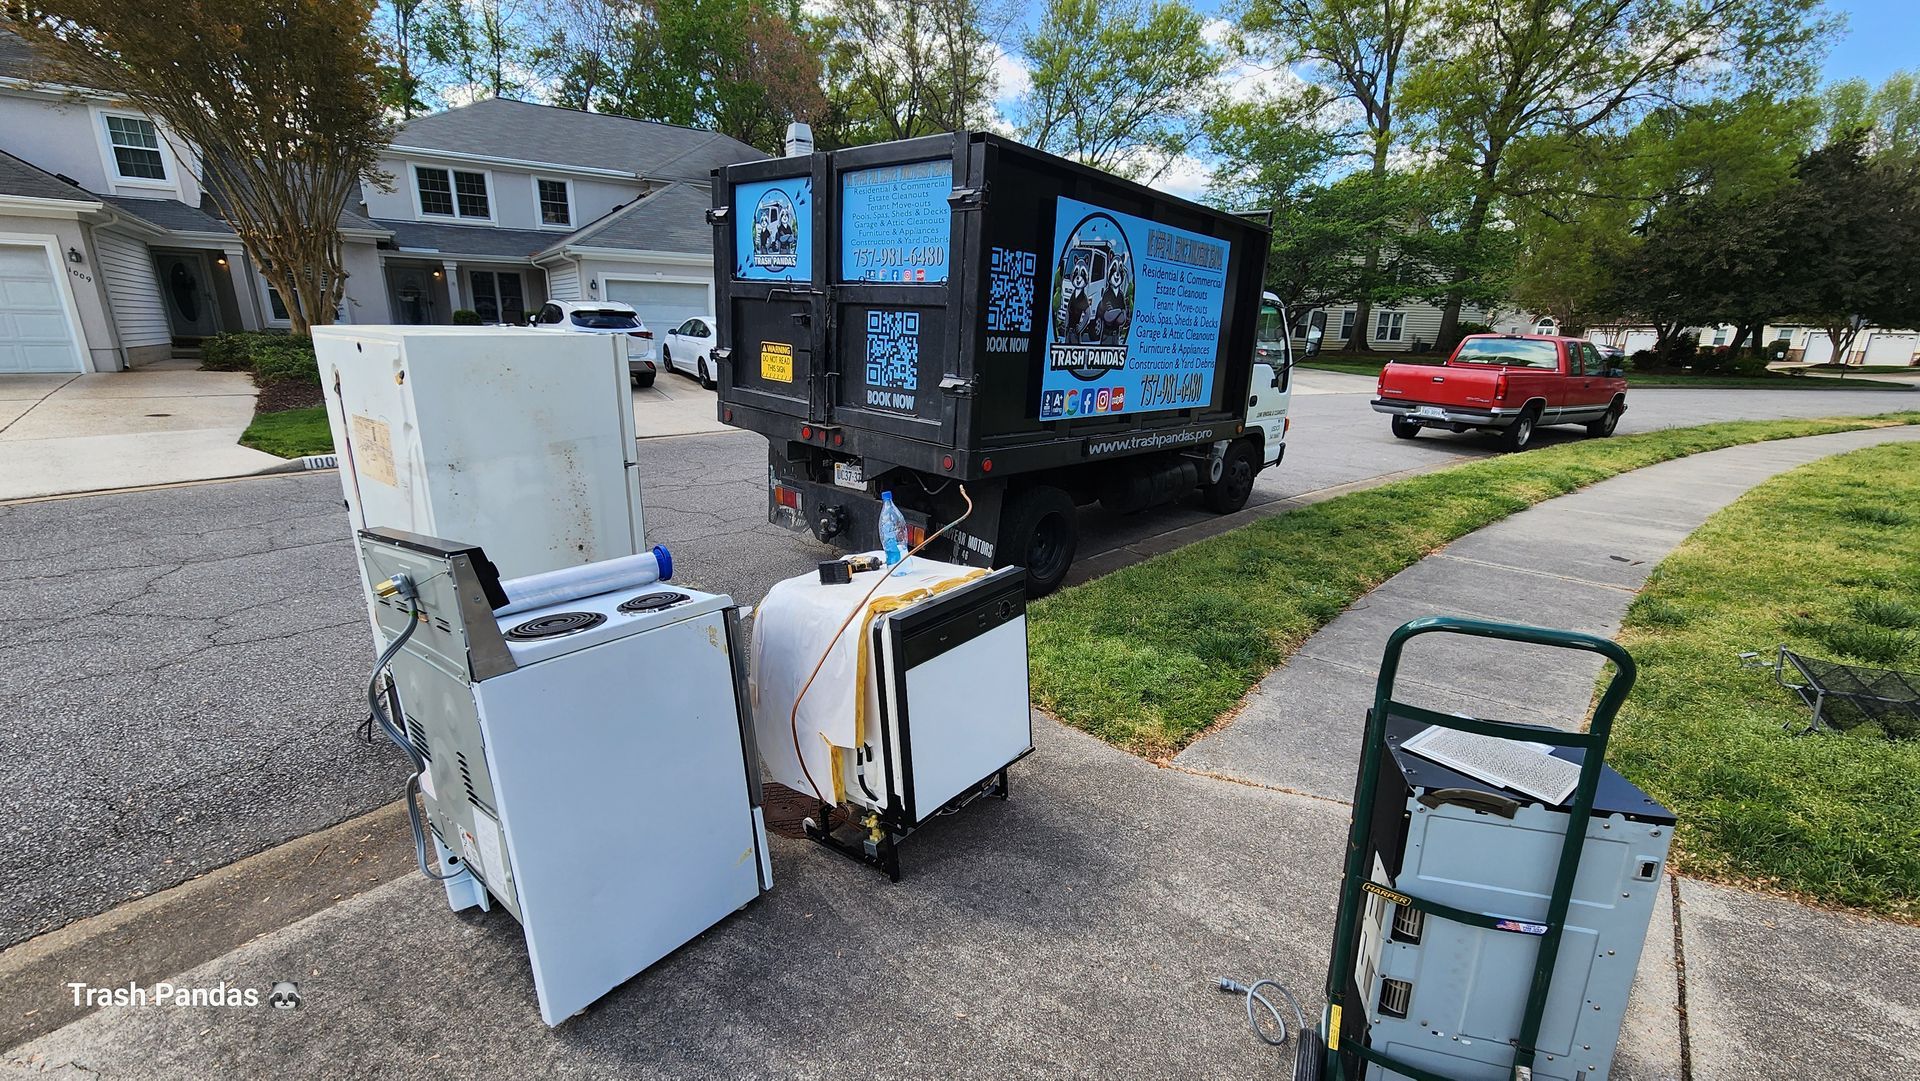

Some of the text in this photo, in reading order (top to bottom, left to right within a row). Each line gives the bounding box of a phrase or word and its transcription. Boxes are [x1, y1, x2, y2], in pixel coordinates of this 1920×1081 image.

[853, 186, 890, 195] Residential
[900, 180, 947, 190] Commercial
[891, 191, 929, 200] Cleanouts
[867, 201, 931, 212] Tenant Move-outs
[891, 210, 912, 218] Sheds
[923, 207, 948, 216] Decks
[854, 221, 877, 229] Garage
[887, 219, 904, 227] Attic
[906, 216, 945, 225] Cleanouts
[899, 227, 939, 236] Appliances
[850, 238, 894, 246] Construction
[904, 237, 920, 245] Yard
[922, 235, 949, 244] Debris
[754, 256, 796, 267] TRASH PANDAS
[853, 245, 945, 267] 757-981-6480
[68, 266, 92, 283] 1009
[1142, 263, 1224, 288] Residential & Commercial
[1156, 281, 1208, 300] Estate Cleanouts
[1153, 297, 1208, 315] Tenant Move-outs
[1135, 310, 1218, 329] Pools, Spas, Sheds & Decks
[1135, 325, 1215, 342] Garage & Attic Cleanouts
[766, 344, 791, 355] WARNING
[1009, 337, 1030, 353] NOW
[1139, 341, 1210, 357] Furniture & Appliances
[779, 356, 791, 366] READ
[1051, 350, 1125, 367] TRASH PANDAS
[1128, 357, 1215, 370] Construction & Yard Debris
[1140, 372, 1204, 407] 757-981-6480
[867, 389, 915, 411] BOOK NOW
[1088, 428, 1213, 455] www.trashpandas.pro
[308, 456, 338, 469] 100
[967, 534, 994, 559] MOTORS
[1365, 884, 1409, 904] HARPER
